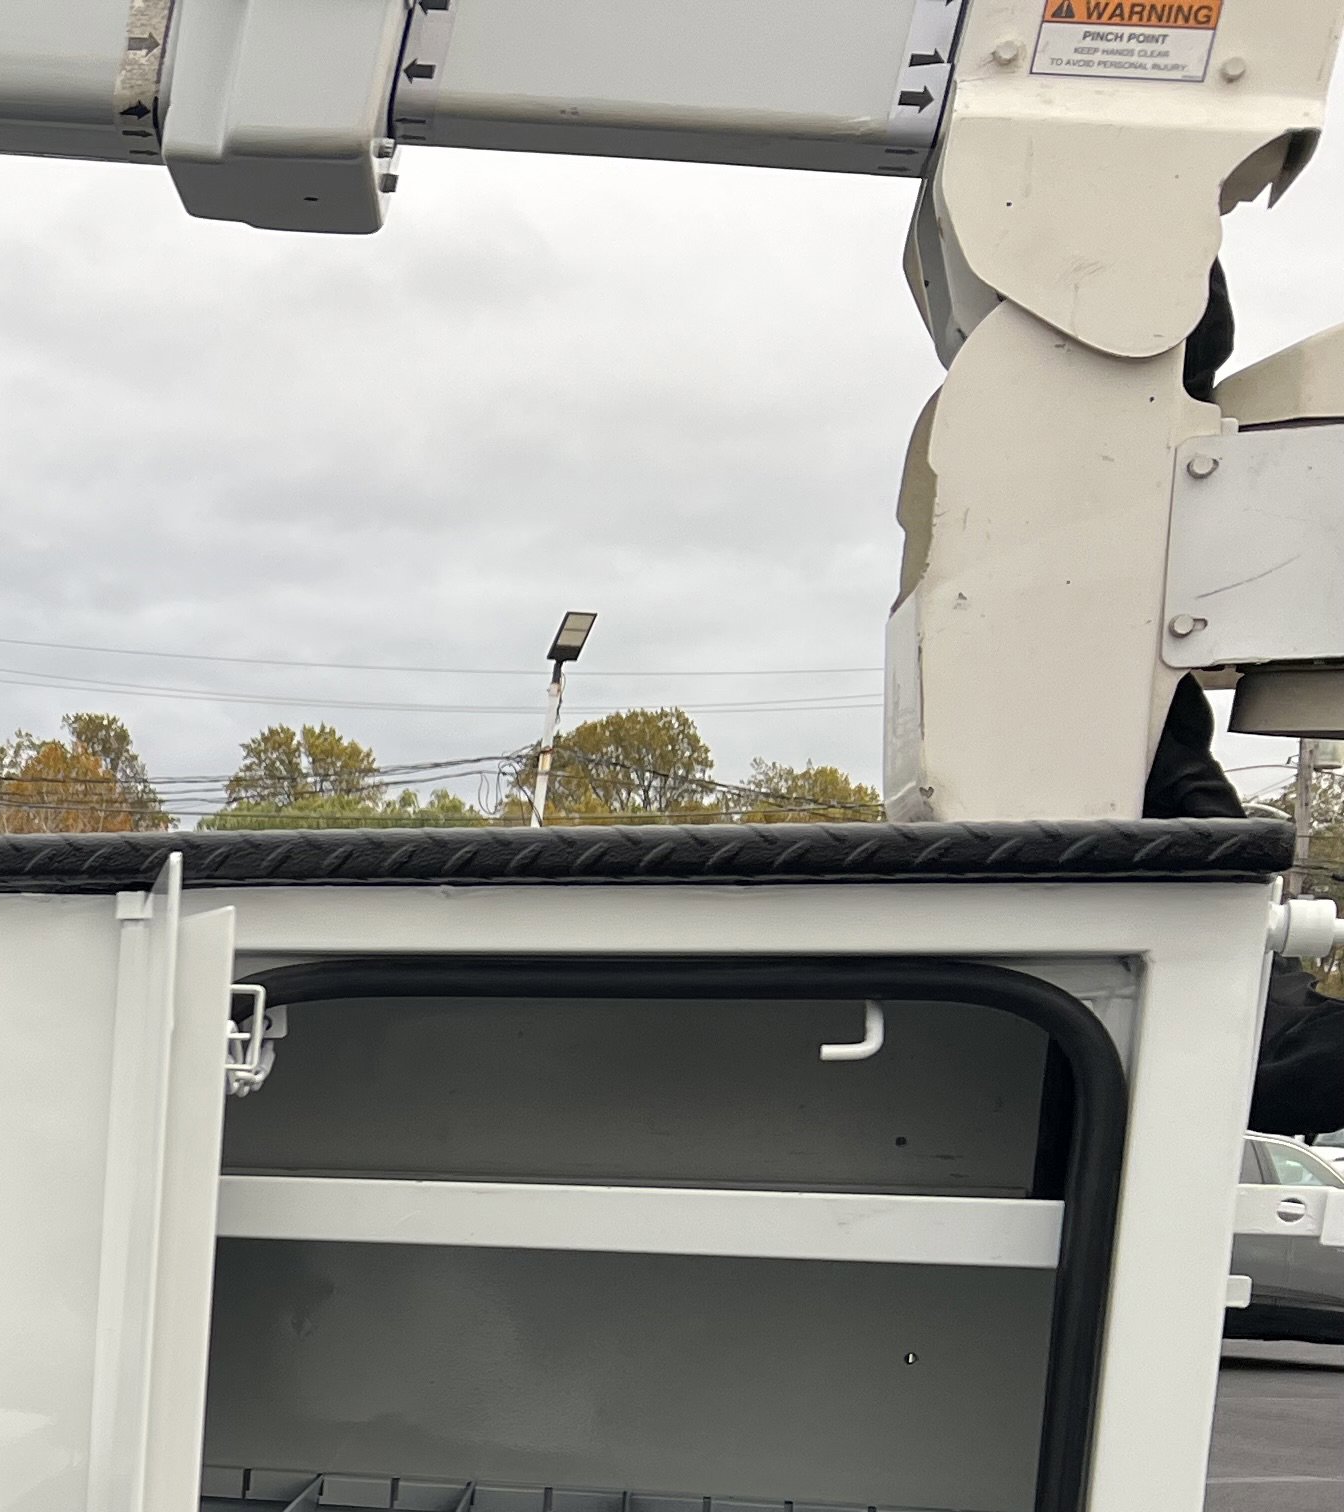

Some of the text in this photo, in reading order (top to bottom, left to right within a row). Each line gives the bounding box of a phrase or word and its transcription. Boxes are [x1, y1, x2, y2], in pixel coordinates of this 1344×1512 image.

[1085, 1, 1213, 25] WARNING
[1082, 31, 1169, 45] PINCH POINT
[1074, 47, 1170, 58] KEEP HANDS CLEAR
[1050, 57, 1188, 72] TO AVOID PERSONAL INJURY
